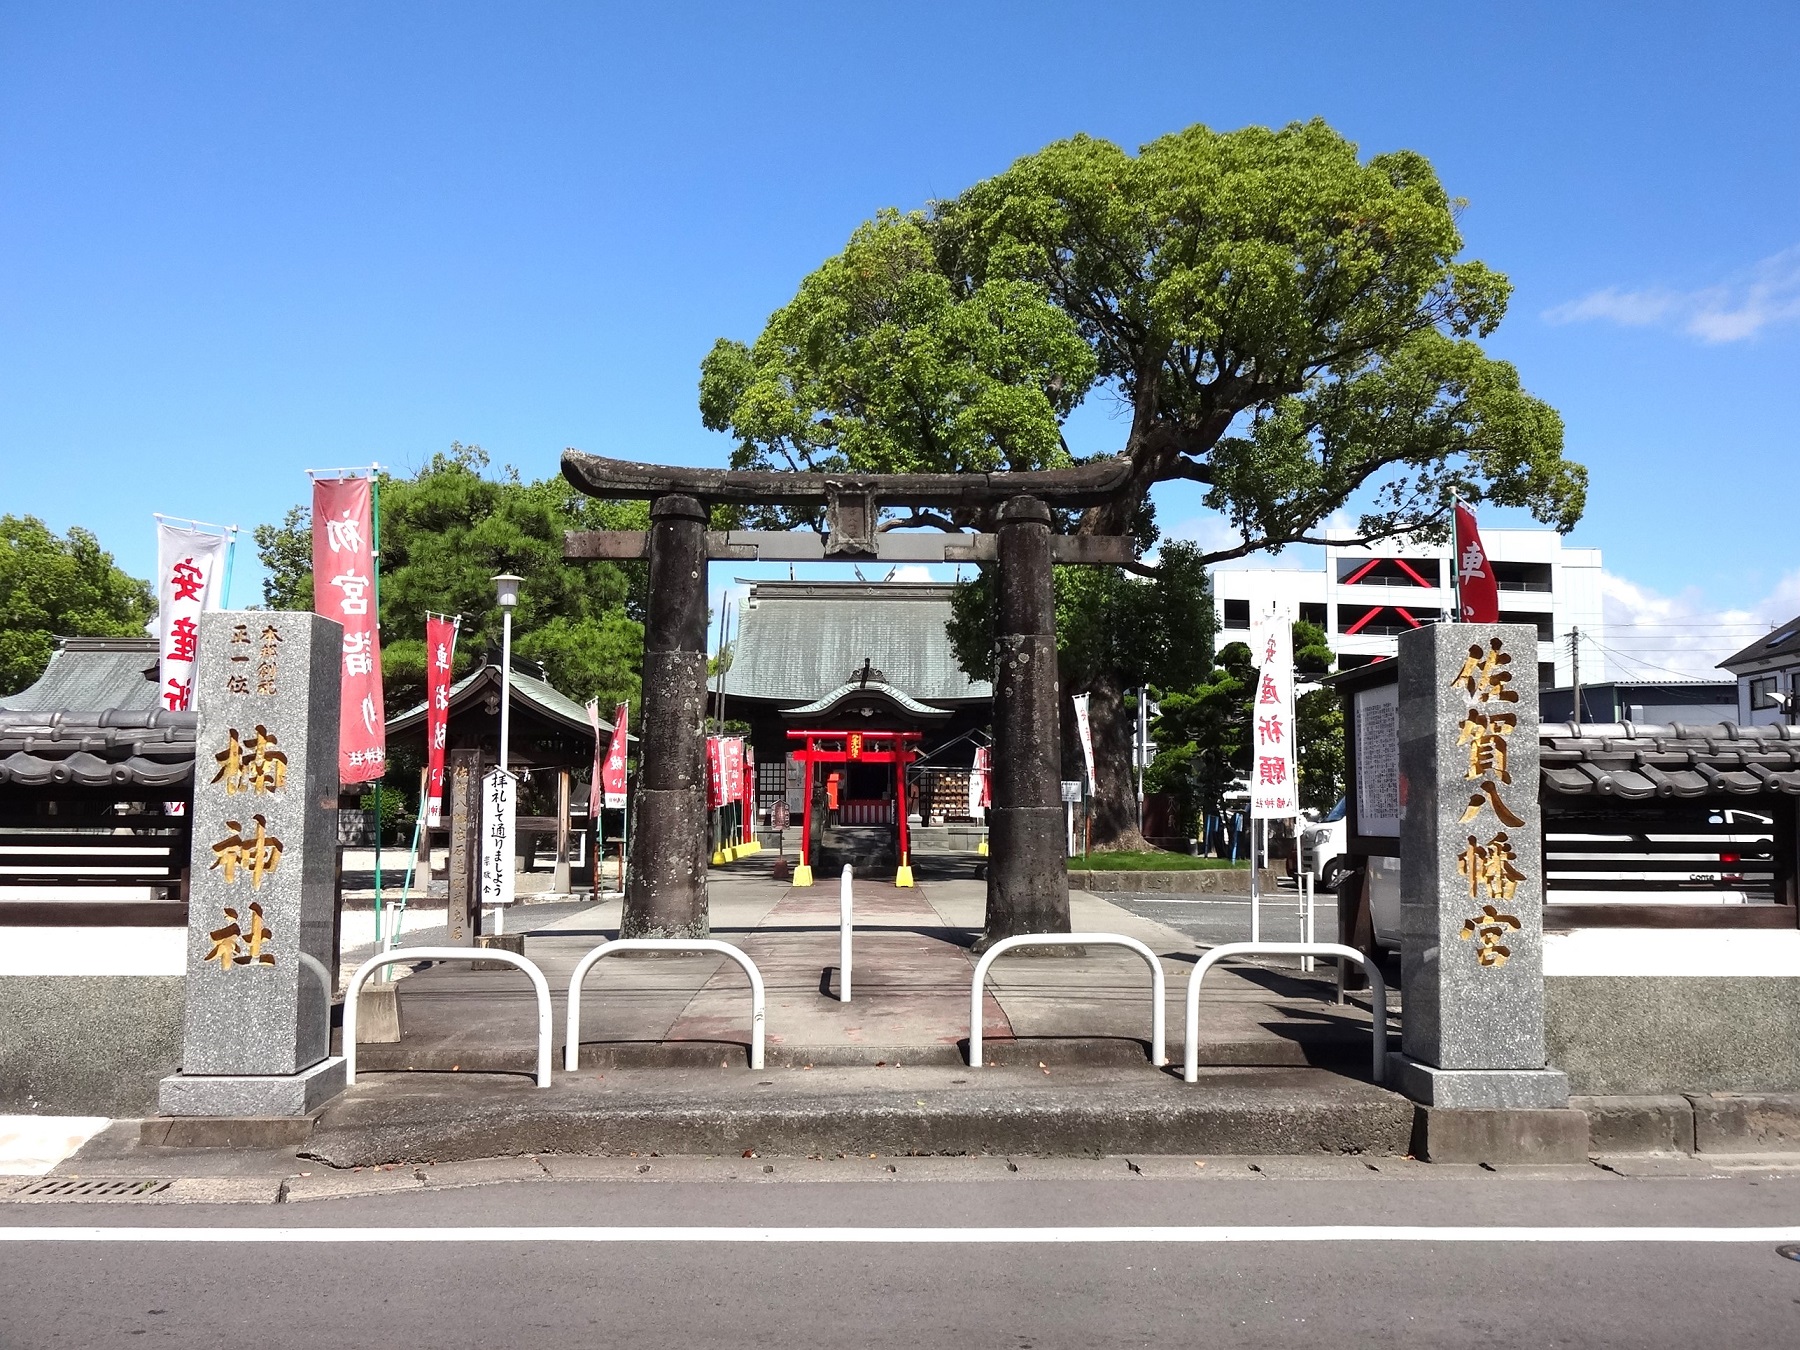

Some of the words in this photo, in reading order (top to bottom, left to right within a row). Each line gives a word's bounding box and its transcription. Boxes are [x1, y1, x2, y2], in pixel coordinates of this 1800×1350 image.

[226, 625, 251, 695] 正一位
[204, 724, 289, 971] 楠神社
[1450, 637, 1527, 968] 佐賀八幡宮
